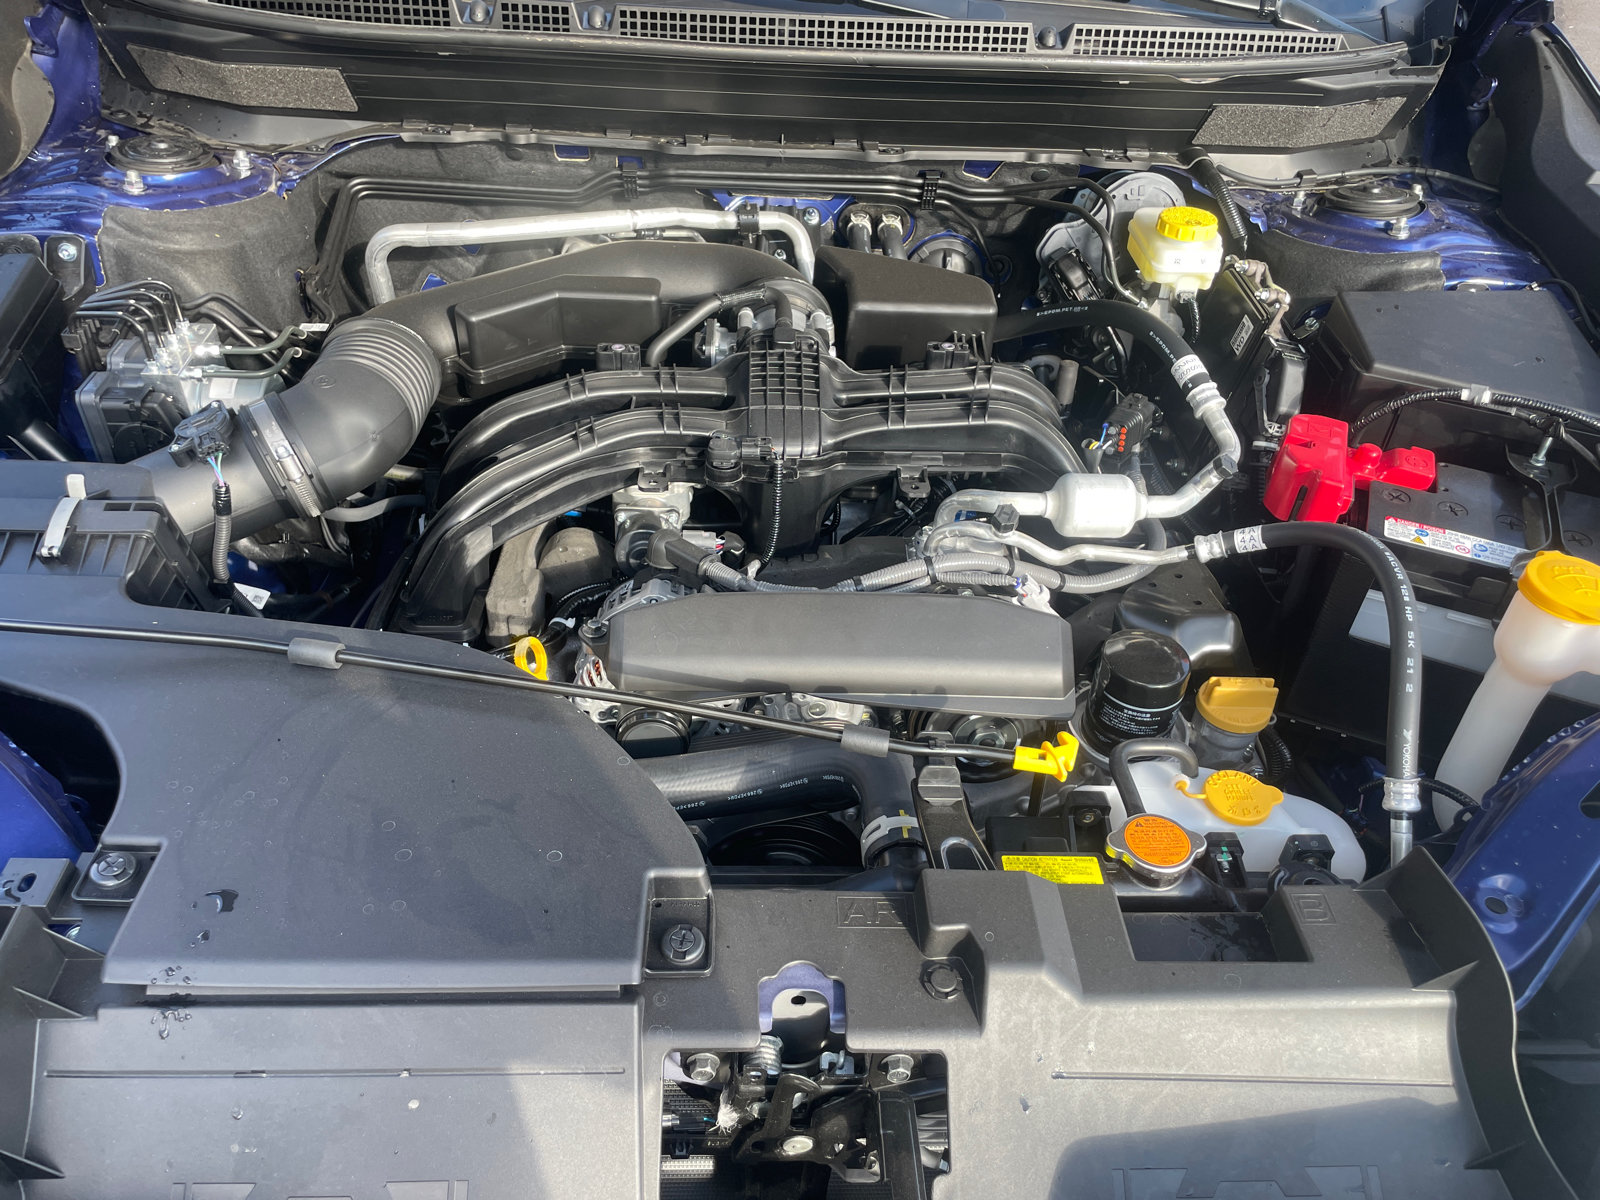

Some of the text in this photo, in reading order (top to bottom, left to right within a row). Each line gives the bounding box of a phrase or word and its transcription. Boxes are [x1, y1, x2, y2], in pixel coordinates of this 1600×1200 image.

[1397, 518, 1420, 529] DANGER
[1404, 605, 1413, 622] HP
[1406, 657, 1415, 674] 21
[1405, 682, 1414, 693] 2
